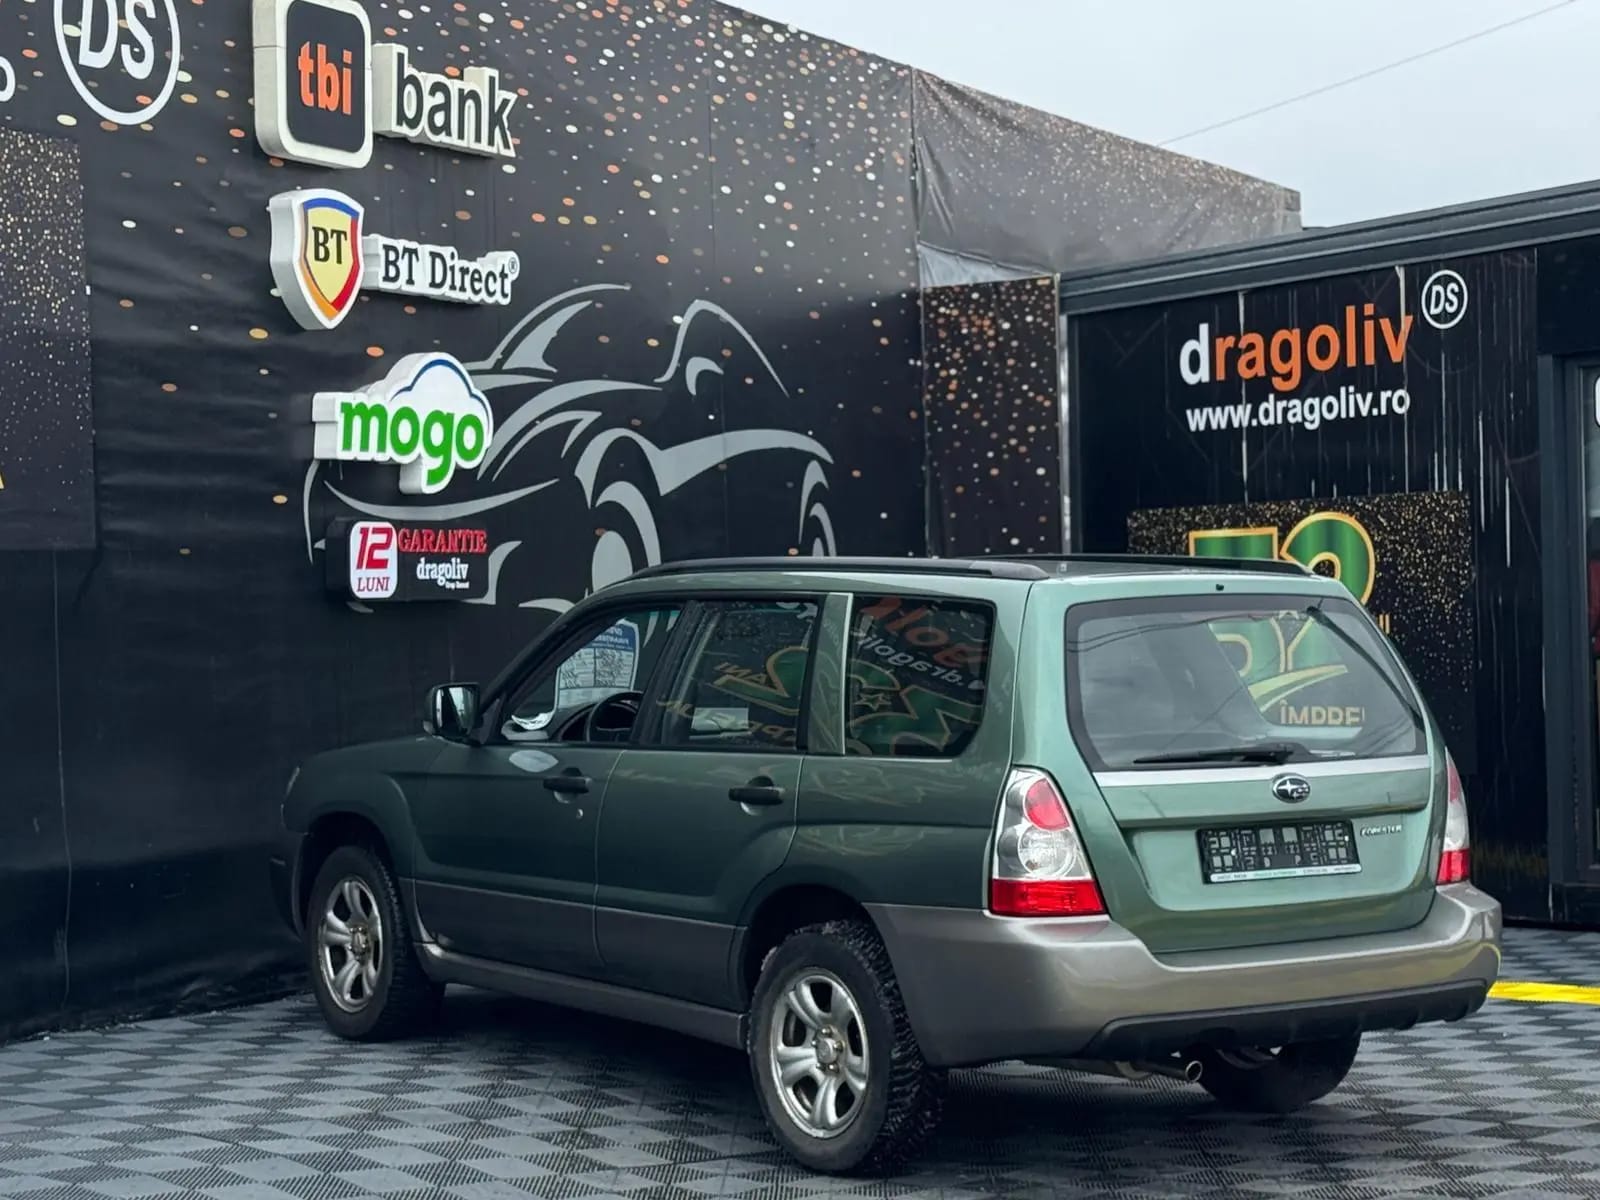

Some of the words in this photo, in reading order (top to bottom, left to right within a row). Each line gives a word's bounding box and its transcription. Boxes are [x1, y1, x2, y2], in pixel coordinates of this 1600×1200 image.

[79, 0, 156, 80] DS
[298, 41, 352, 115] tbi
[396, 51, 516, 152] bank
[312, 226, 348, 265] BT
[382, 244, 420, 286] BT
[1430, 281, 1459, 315] DS
[1180, 303, 1413, 392] dragoliv
[1186, 386, 1410, 431] www.dragoliv.ro
[340, 400, 485, 487] mogo
[356, 527, 393, 570] 12
[398, 528, 488, 553] GARANTIE
[357, 576, 390, 592] LUNI
[416, 557, 469, 586] dragoliv
